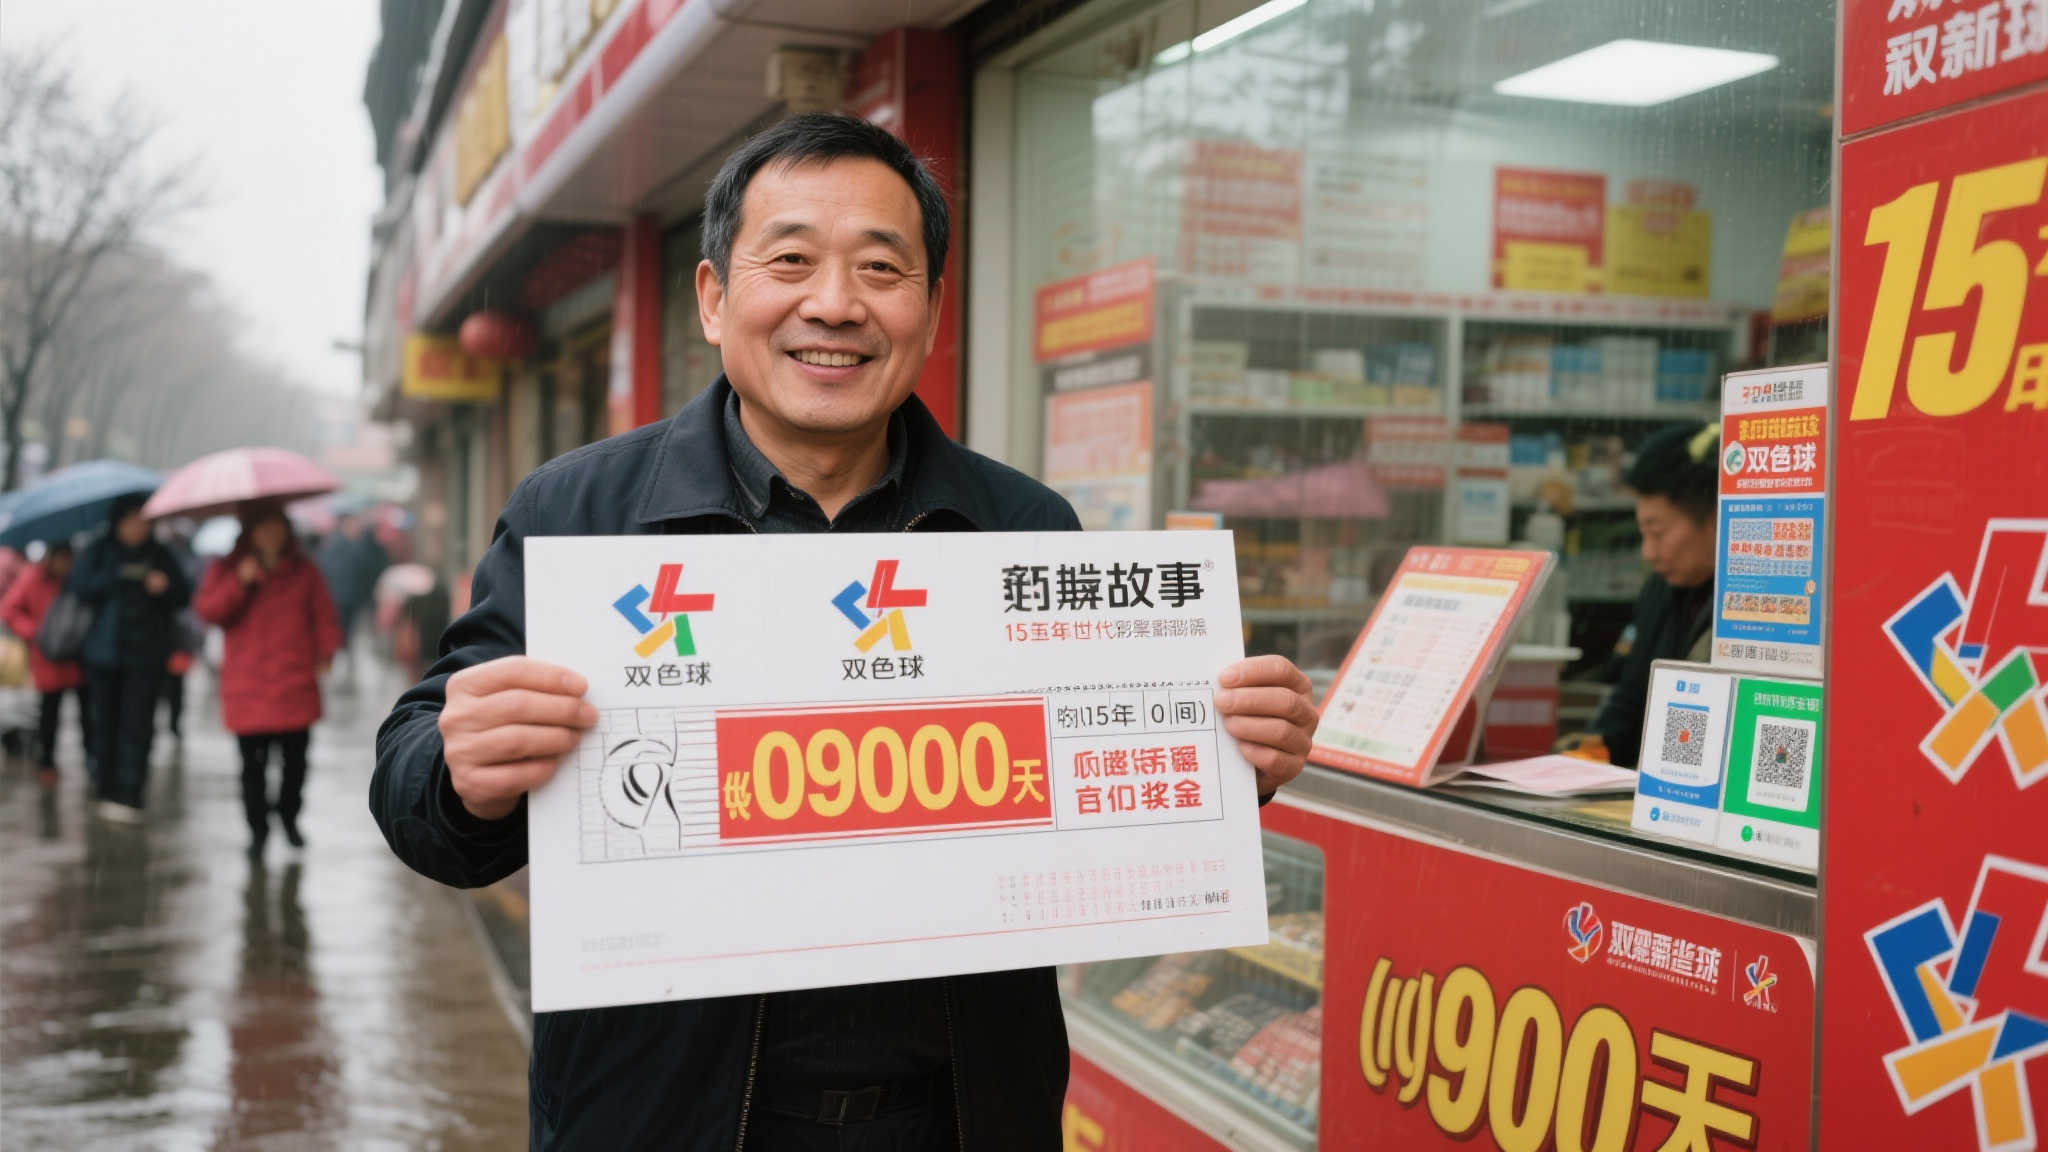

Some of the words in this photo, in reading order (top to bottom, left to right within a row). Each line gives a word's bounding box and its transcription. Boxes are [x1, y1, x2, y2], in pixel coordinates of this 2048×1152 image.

[1849, 156, 2048, 421] 15
[1746, 441, 1817, 473] 双色球
[624, 661, 713, 688] 双色球
[840, 655, 925, 681] 双色球
